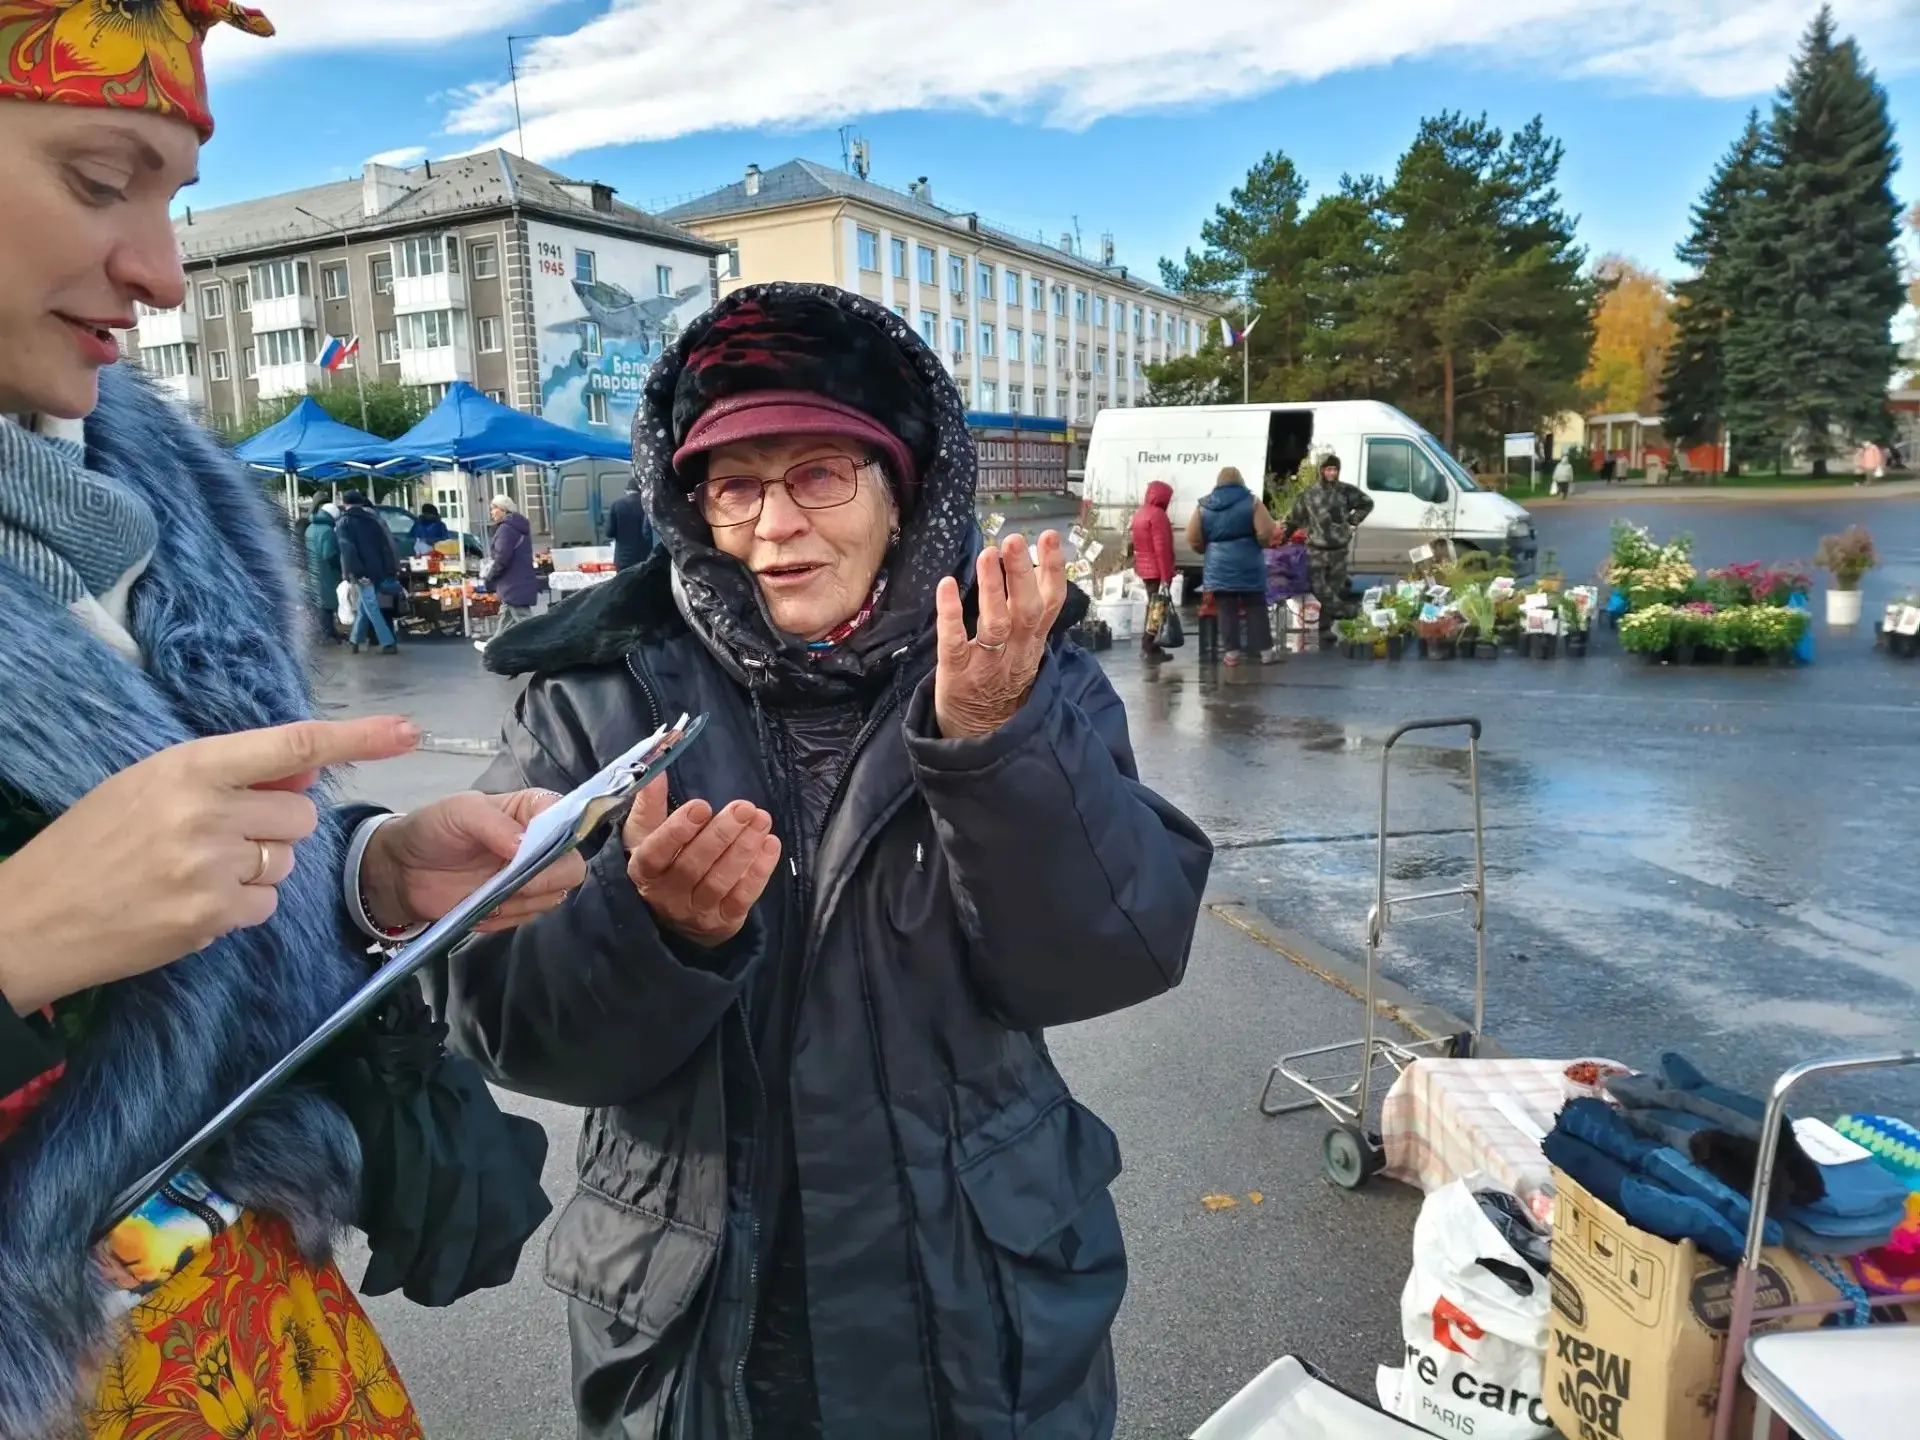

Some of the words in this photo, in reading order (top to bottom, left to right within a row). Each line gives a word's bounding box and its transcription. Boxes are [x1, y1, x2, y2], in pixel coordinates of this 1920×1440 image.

[537, 242, 562, 259] 1941
[538, 259, 565, 276] 1945
[1177, 453, 1218, 464] грузы
[1554, 1328, 1631, 1400] Max
[1423, 1396, 1474, 1436] PARIS
